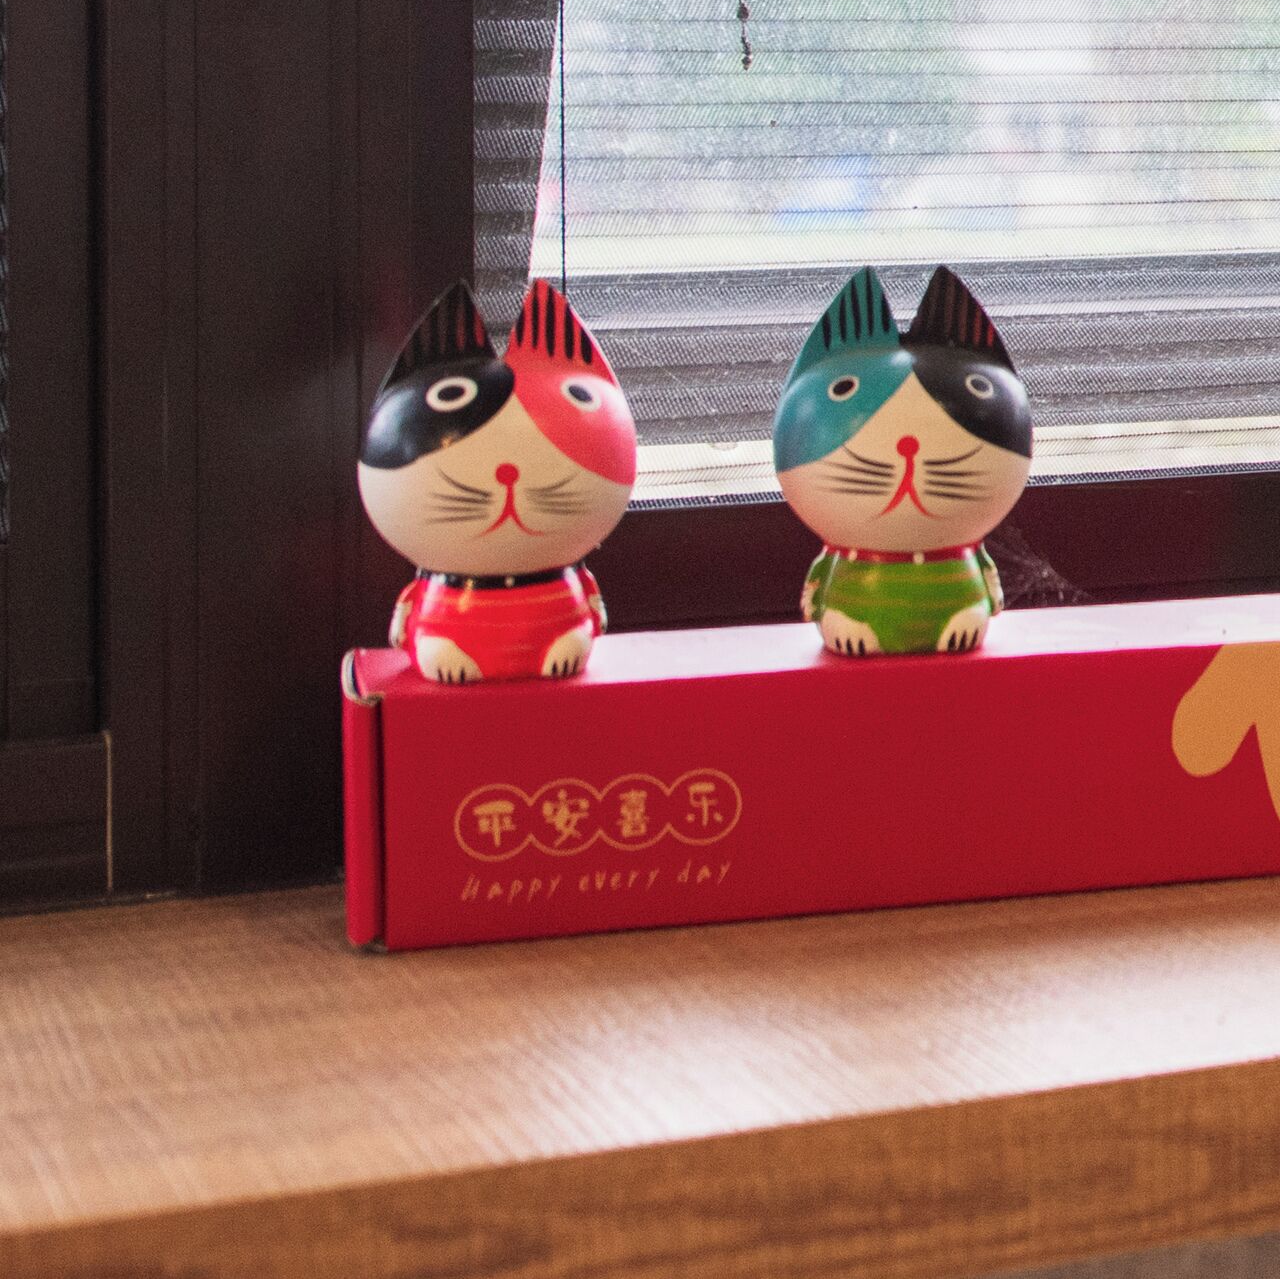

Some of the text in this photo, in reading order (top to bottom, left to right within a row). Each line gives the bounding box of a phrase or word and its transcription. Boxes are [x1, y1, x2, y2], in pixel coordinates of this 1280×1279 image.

[461, 859, 731, 905] Happy every day
